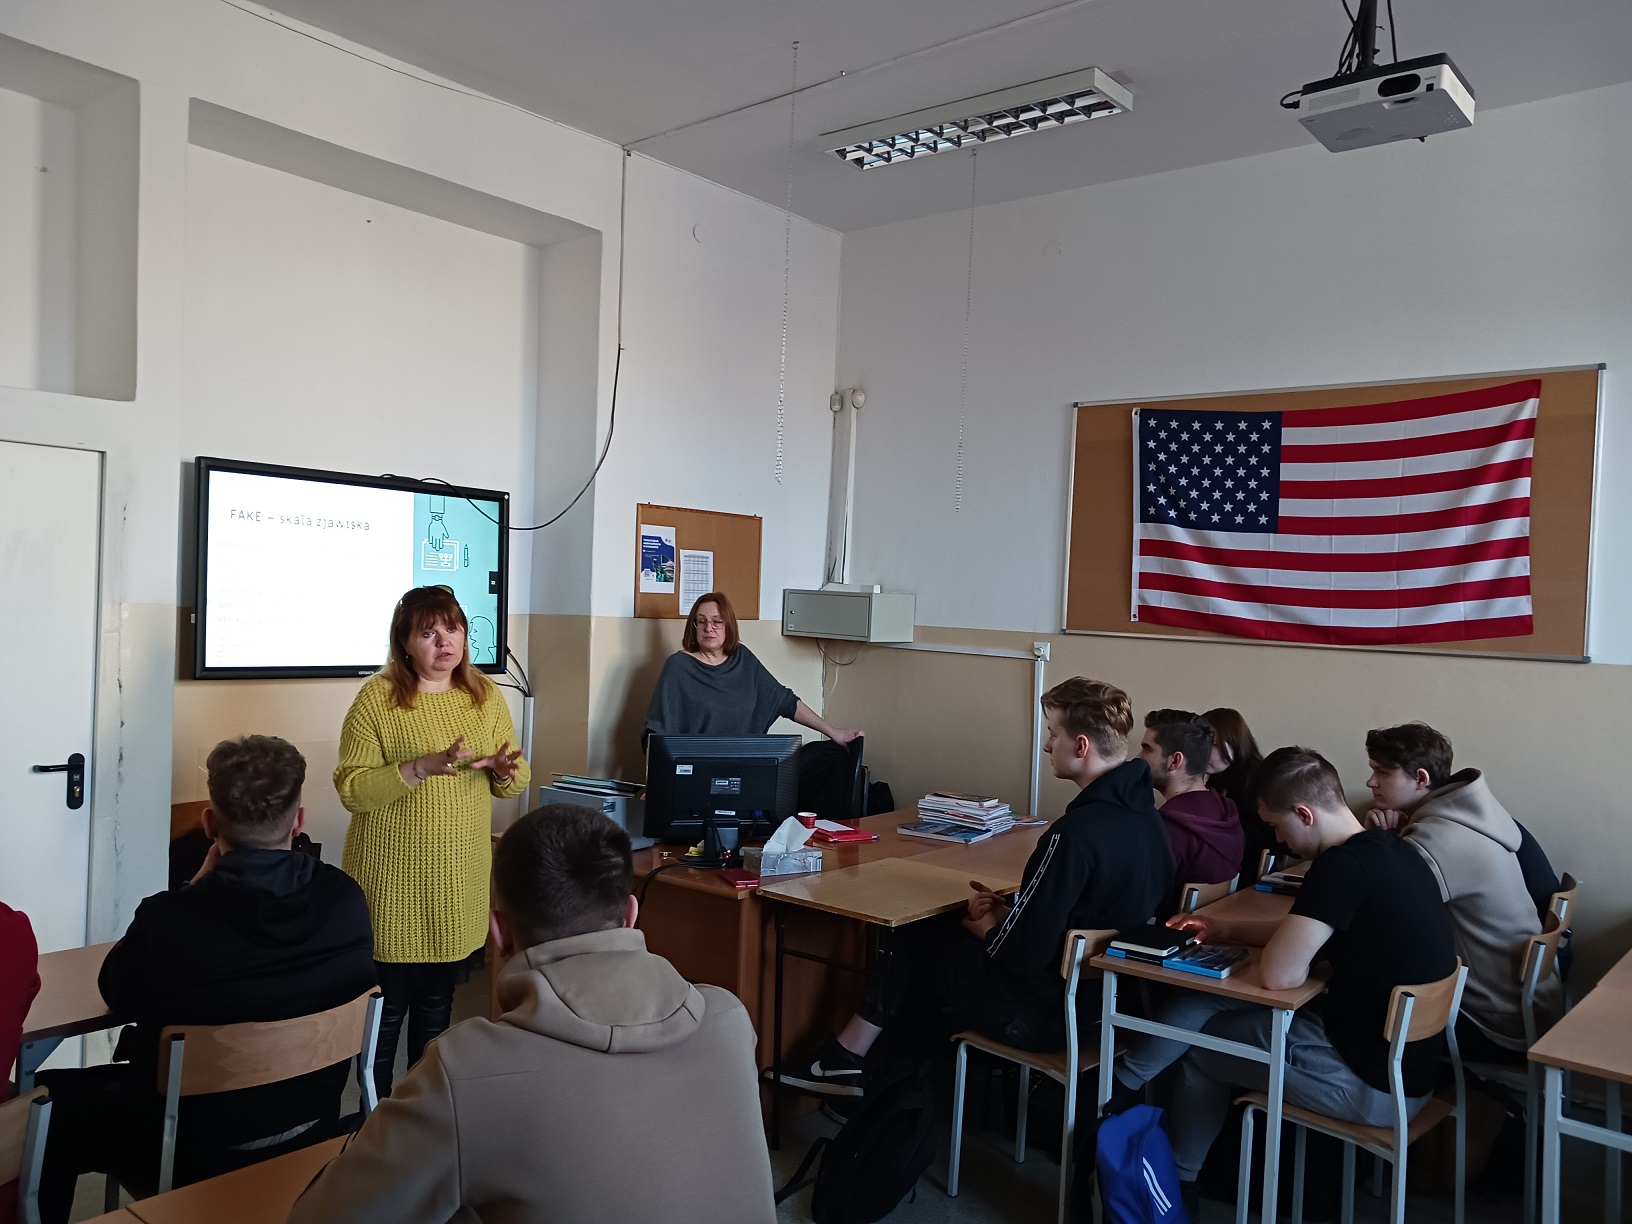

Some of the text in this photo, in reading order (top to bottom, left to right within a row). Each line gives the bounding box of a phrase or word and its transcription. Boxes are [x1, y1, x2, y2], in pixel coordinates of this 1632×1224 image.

[230, 509, 261, 522] FAKE
[279, 514, 312, 526] skala
[316, 517, 370, 531] zjawiska
